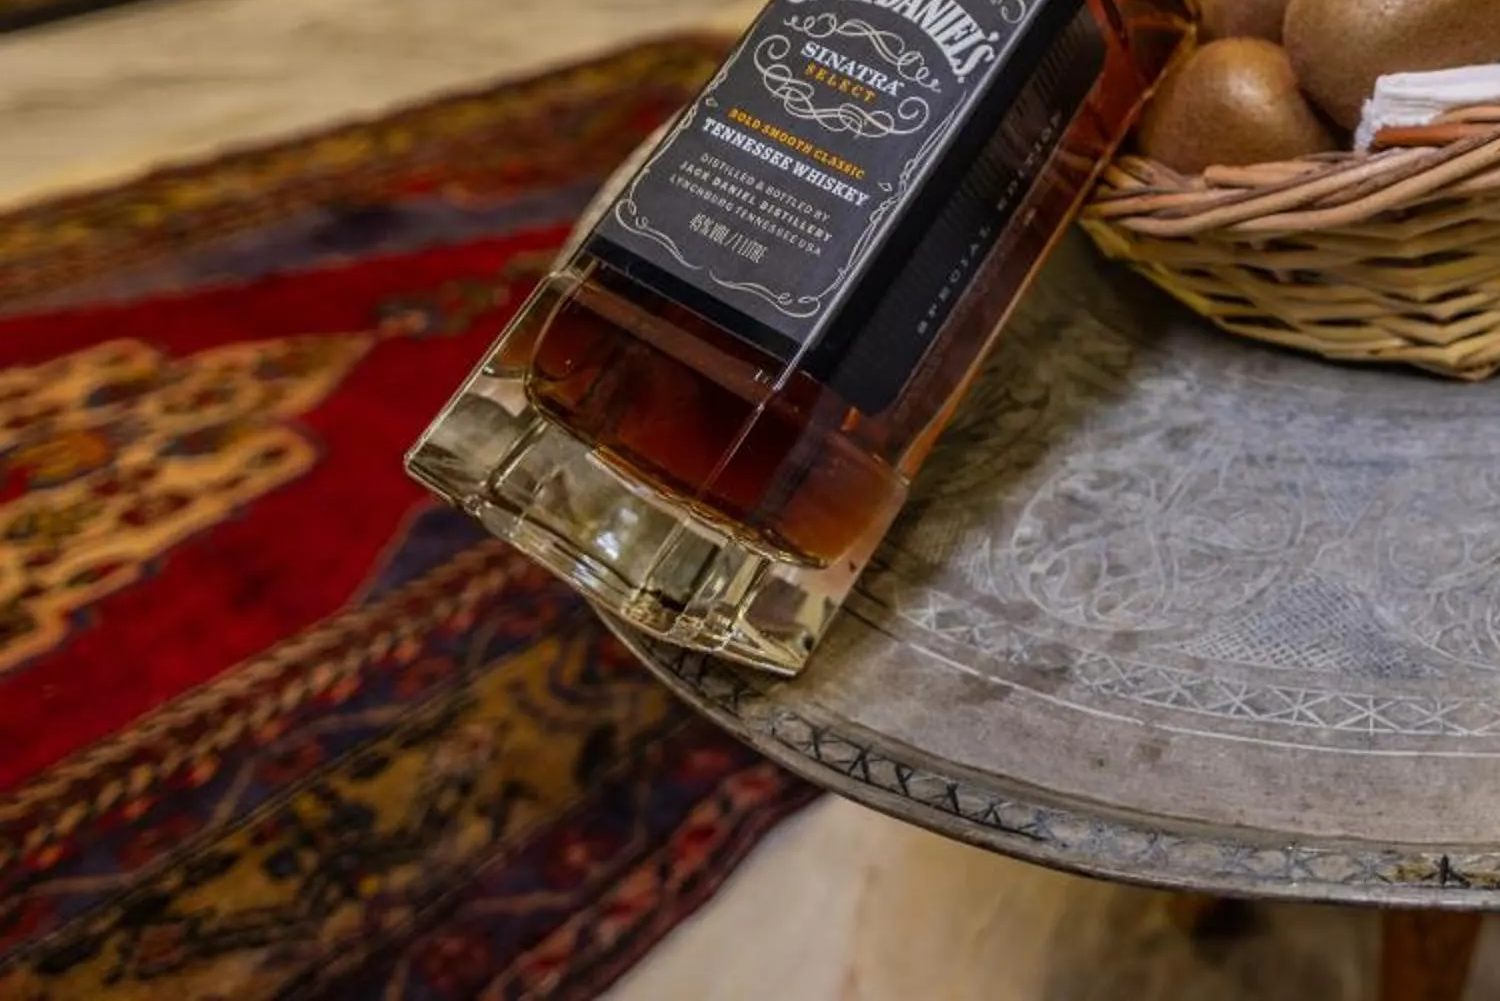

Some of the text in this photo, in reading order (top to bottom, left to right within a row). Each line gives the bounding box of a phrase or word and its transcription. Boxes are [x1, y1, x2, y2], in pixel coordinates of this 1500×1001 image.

[801, 41, 900, 97] SINATRA
[804, 62, 878, 103] SELECT
[702, 117, 871, 207] TENNESSEE WHISKEY
[727, 108, 866, 180] BOLD SMOOTH CLASSIC
[679, 160, 833, 242] JACK DANIEL DISTILLERY
[701, 152, 755, 186] DISTILLED
[765, 185, 813, 214] BOTTLED
[813, 209, 831, 222] BY
[735, 205, 800, 244] TENNESSEE
